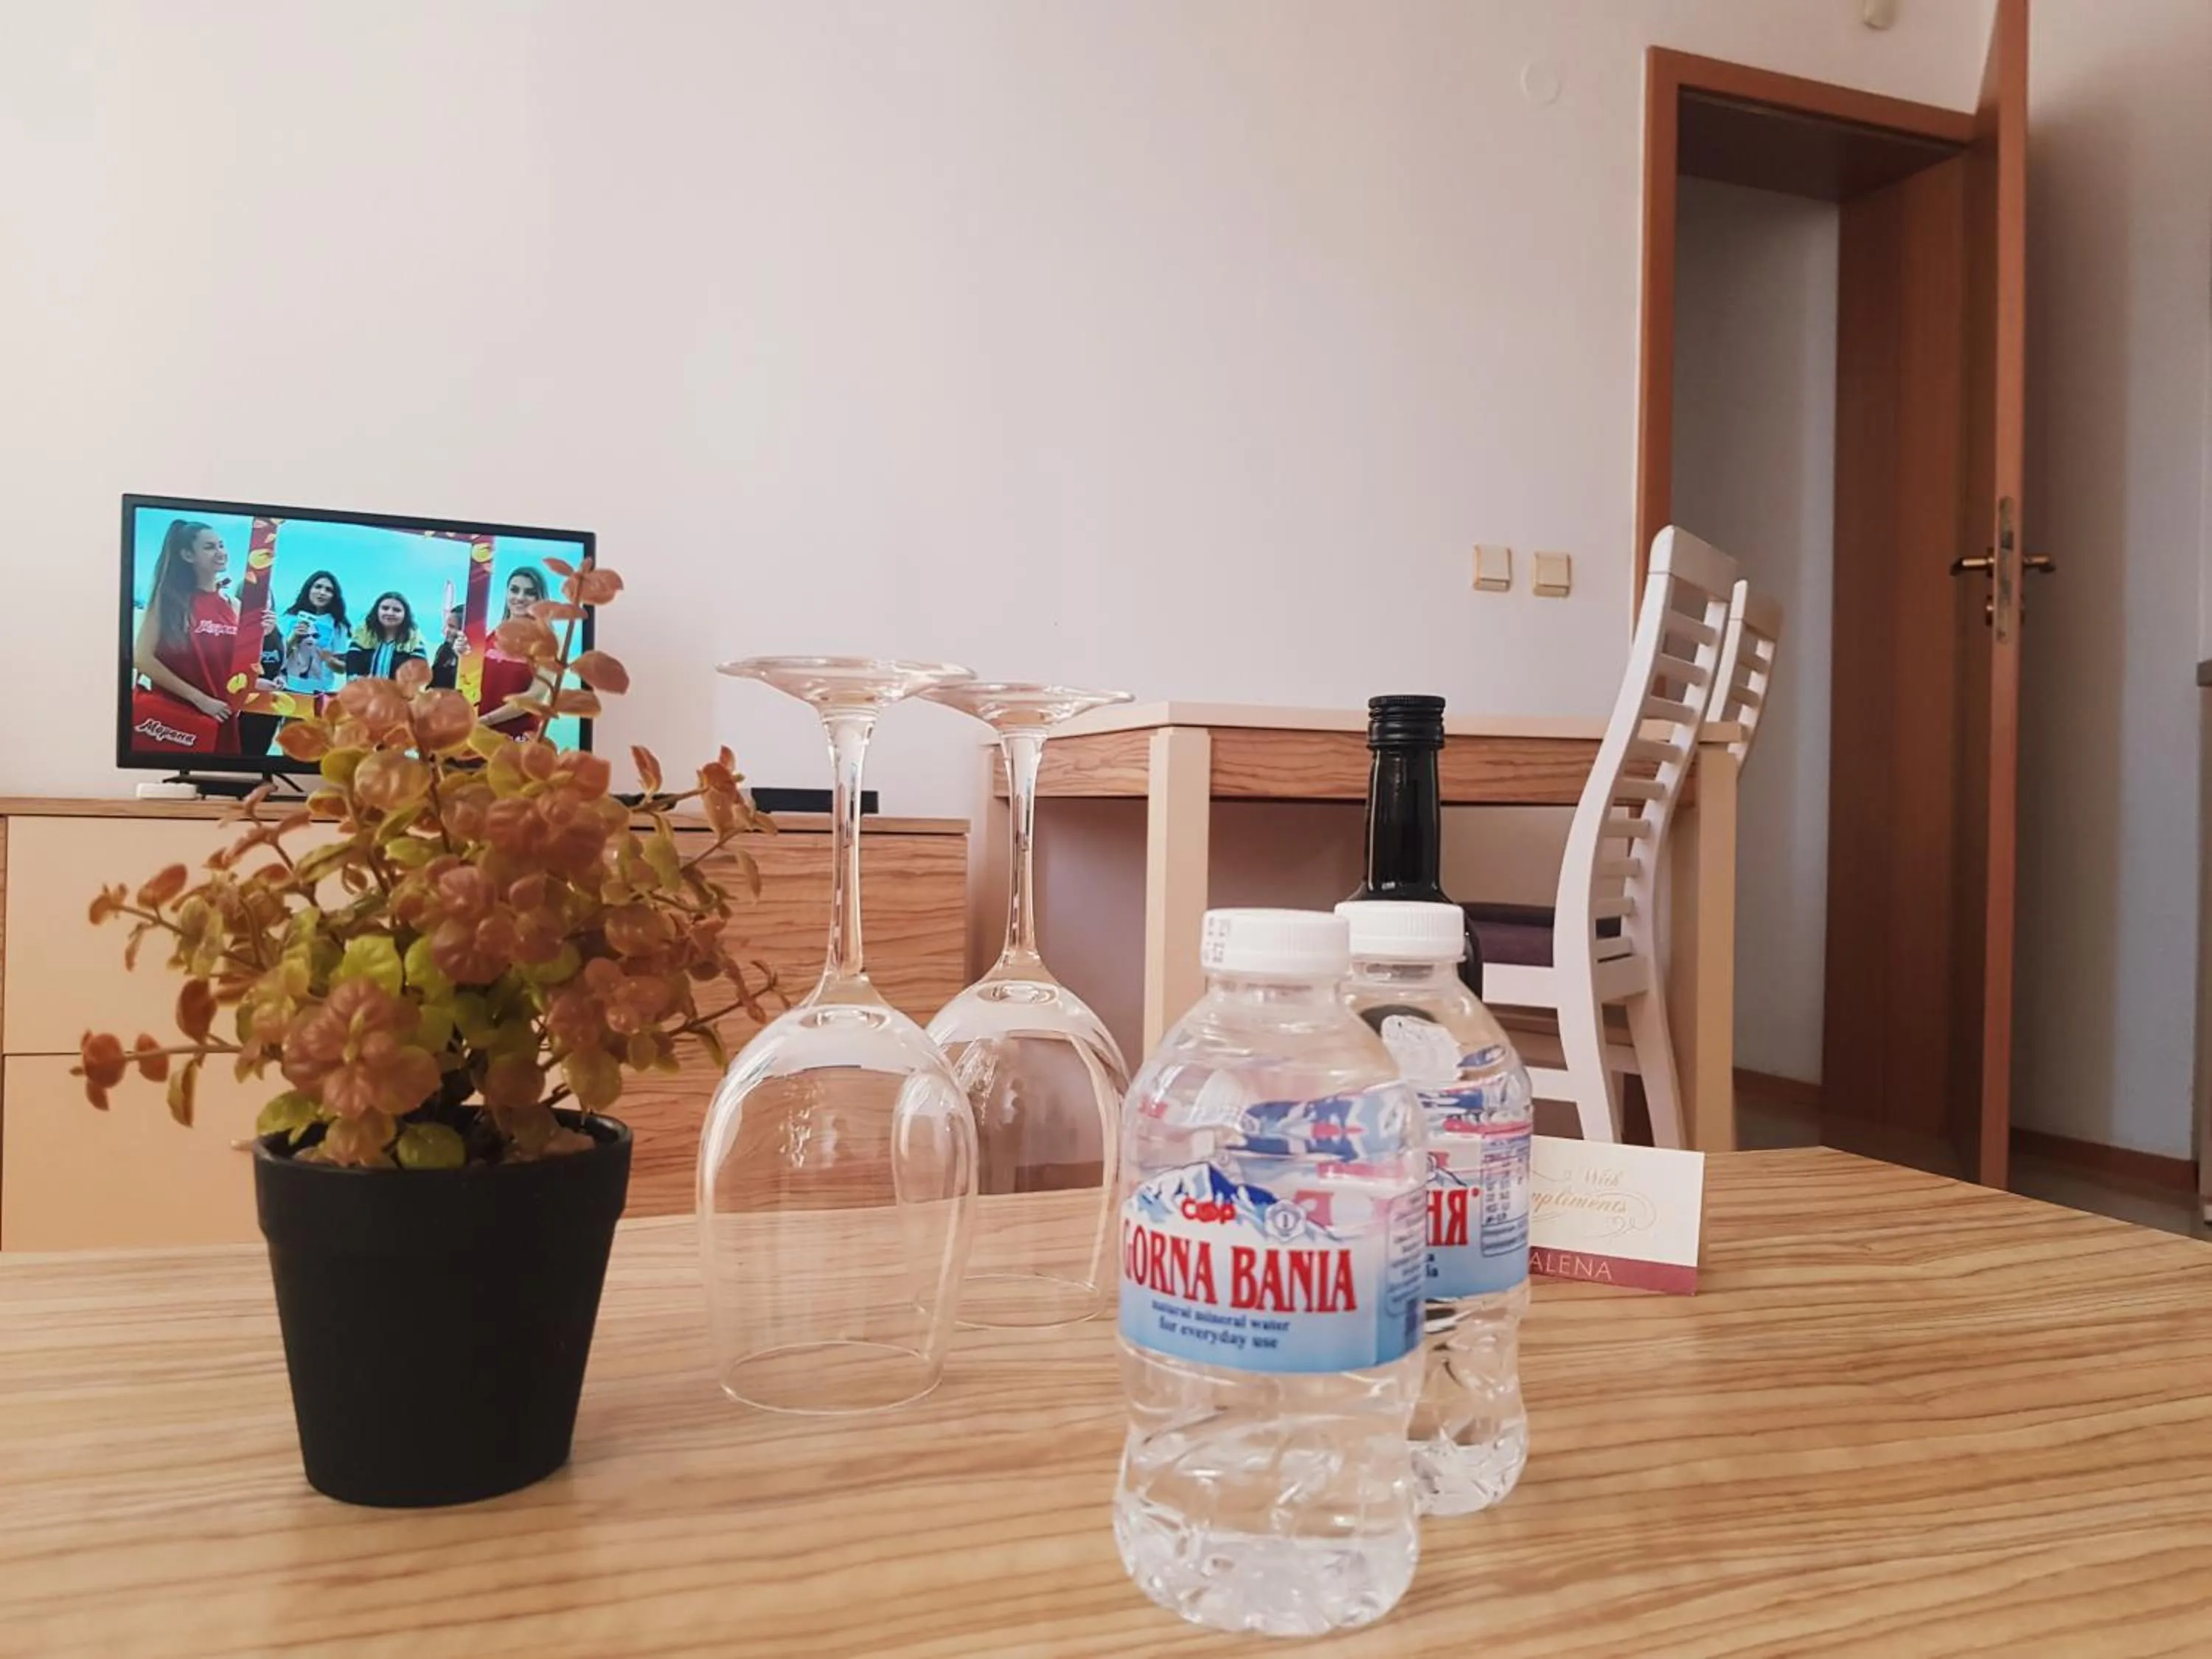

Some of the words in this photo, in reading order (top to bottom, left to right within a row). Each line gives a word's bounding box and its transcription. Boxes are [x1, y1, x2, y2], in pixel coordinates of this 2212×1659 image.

[1427, 1189, 1468, 1246] НЯ
[1123, 1217, 1218, 1304] GORNA
[1229, 1245, 1357, 1313] BANIA
[1529, 1251, 1613, 1281] ALENA
[1180, 1324, 1247, 1350] everyday
[1252, 1335, 1279, 1349] use
